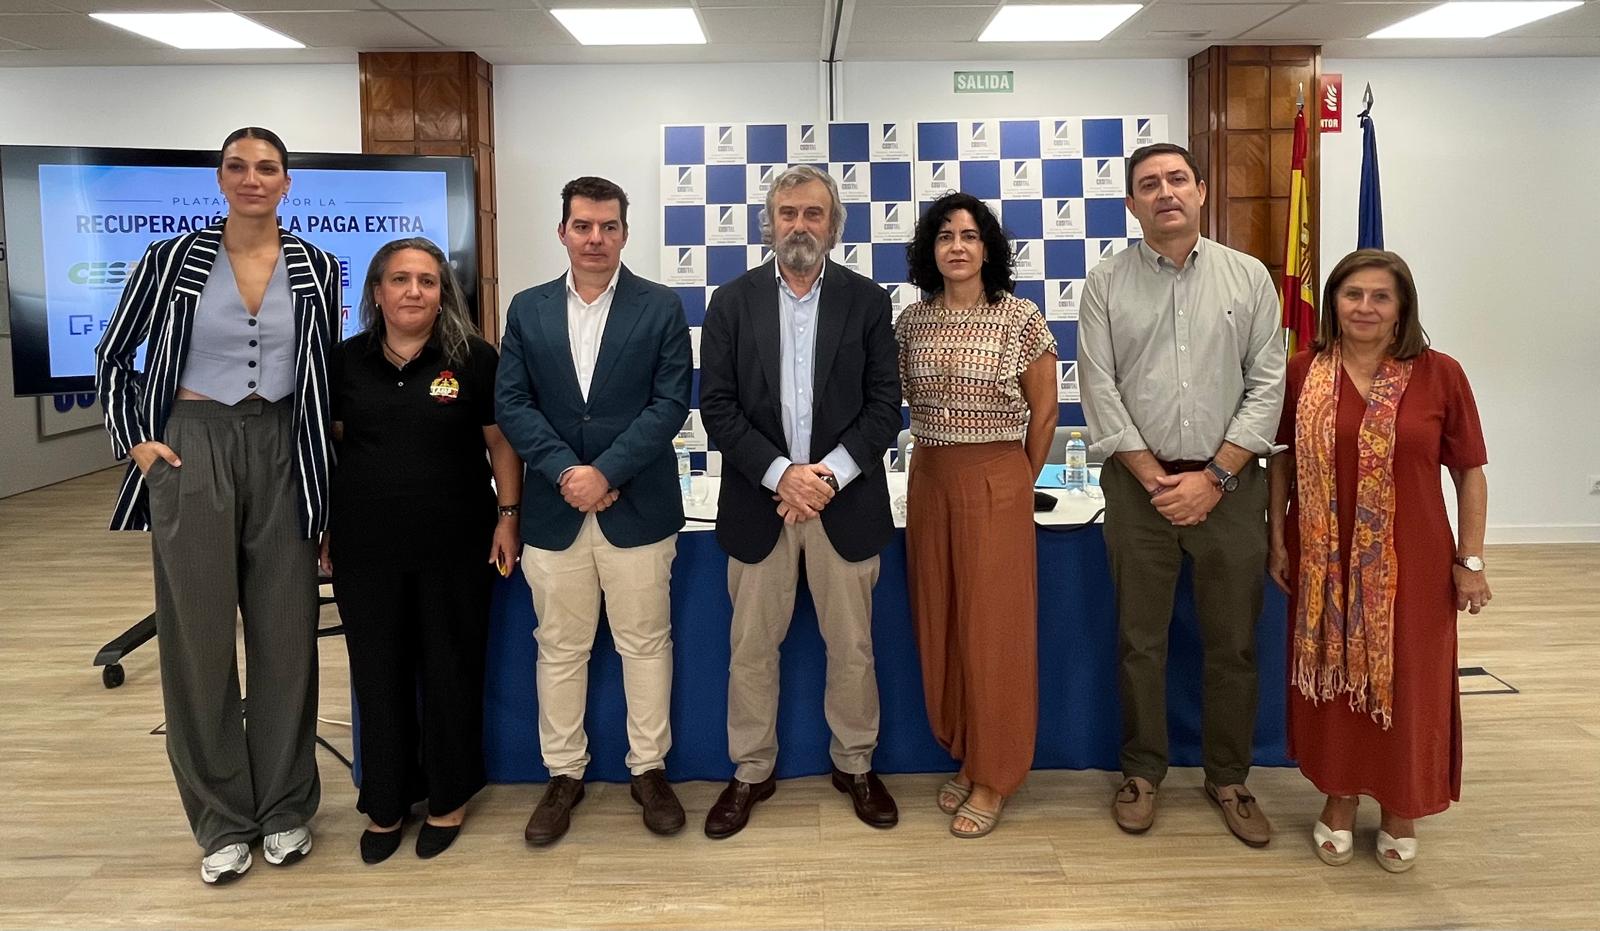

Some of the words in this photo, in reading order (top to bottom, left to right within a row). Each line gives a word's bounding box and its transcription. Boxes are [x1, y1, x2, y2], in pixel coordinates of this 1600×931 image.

[957, 74, 1010, 90] SALIDA
[283, 197, 312, 207] POR
[319, 198, 337, 207] LA
[76, 211, 225, 234] RECUPERACIÓ
[307, 215, 361, 233] PAGA
[365, 215, 425, 233] EXTRA
